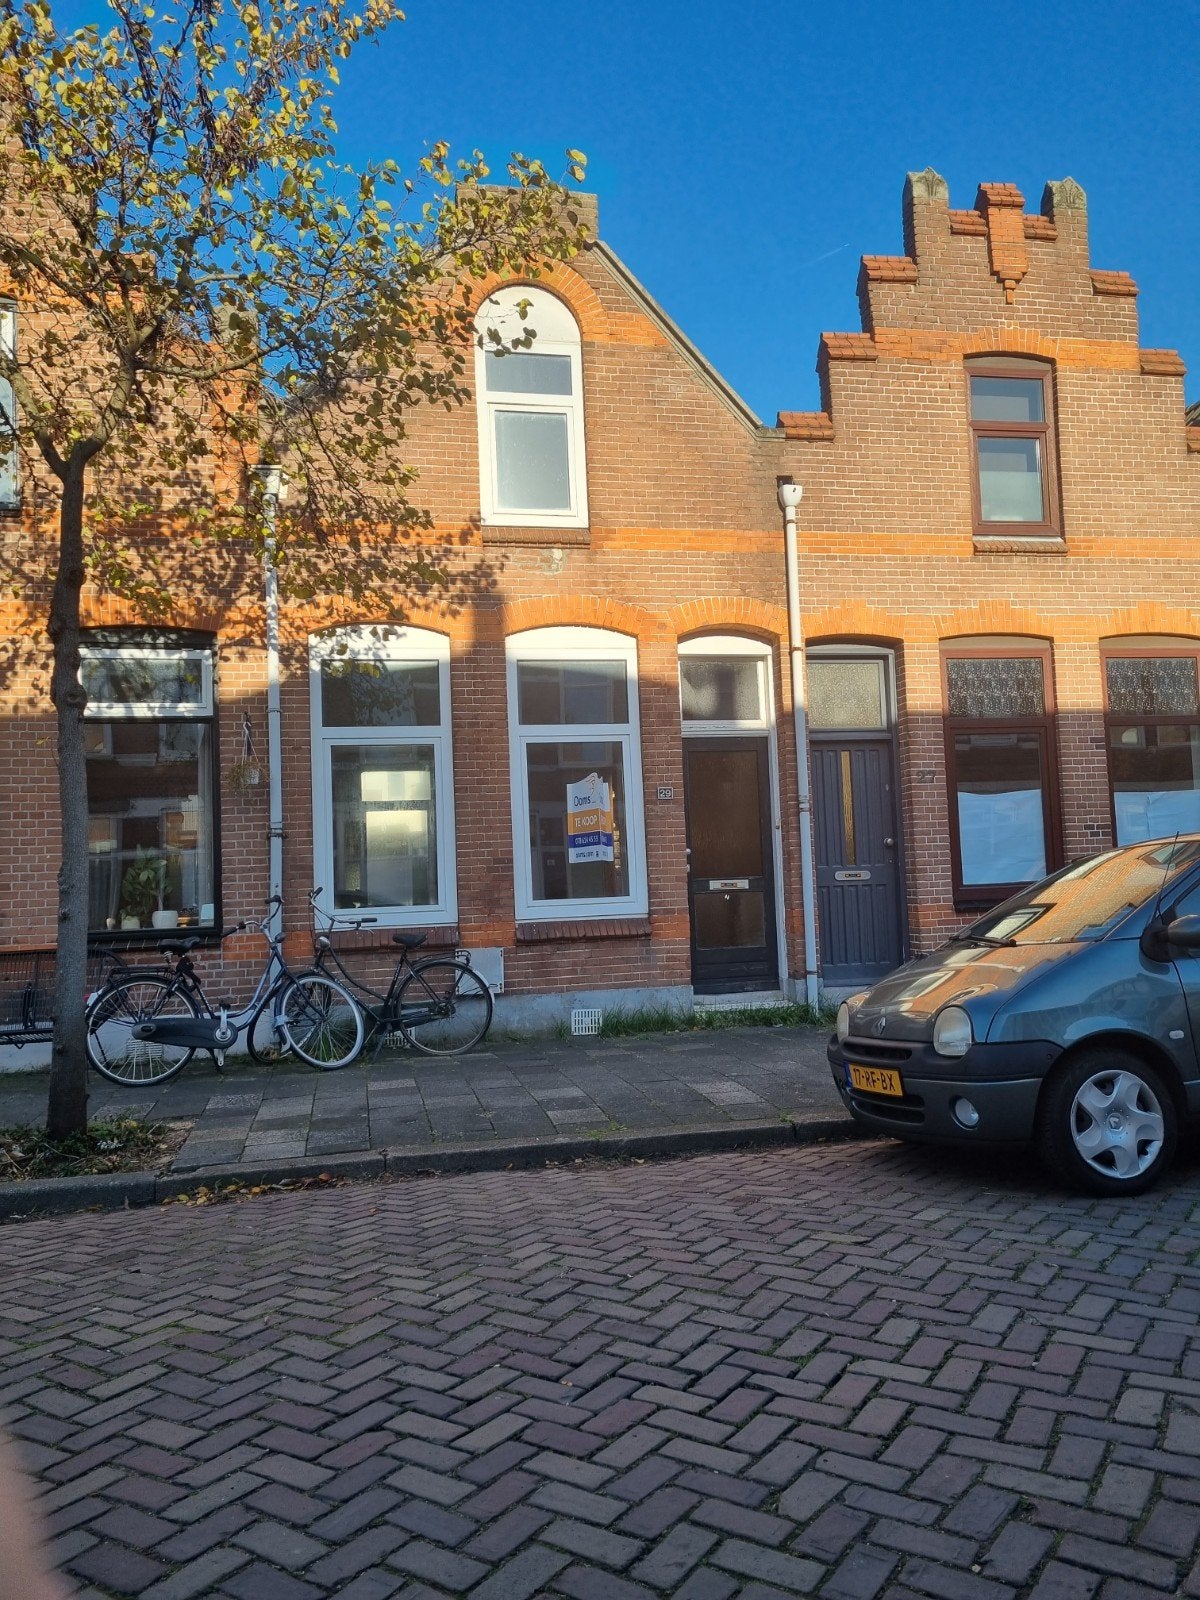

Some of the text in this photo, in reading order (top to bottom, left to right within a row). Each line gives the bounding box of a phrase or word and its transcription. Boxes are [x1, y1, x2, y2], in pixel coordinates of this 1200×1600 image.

[916, 770, 936, 784] 27
[660, 789, 671, 799] 29
[573, 796, 591, 807] Ooms
[574, 817, 581, 828] TE
[582, 815, 598, 826] KOOP
[853, 1068, 896, 1092] 17-RF-BX
